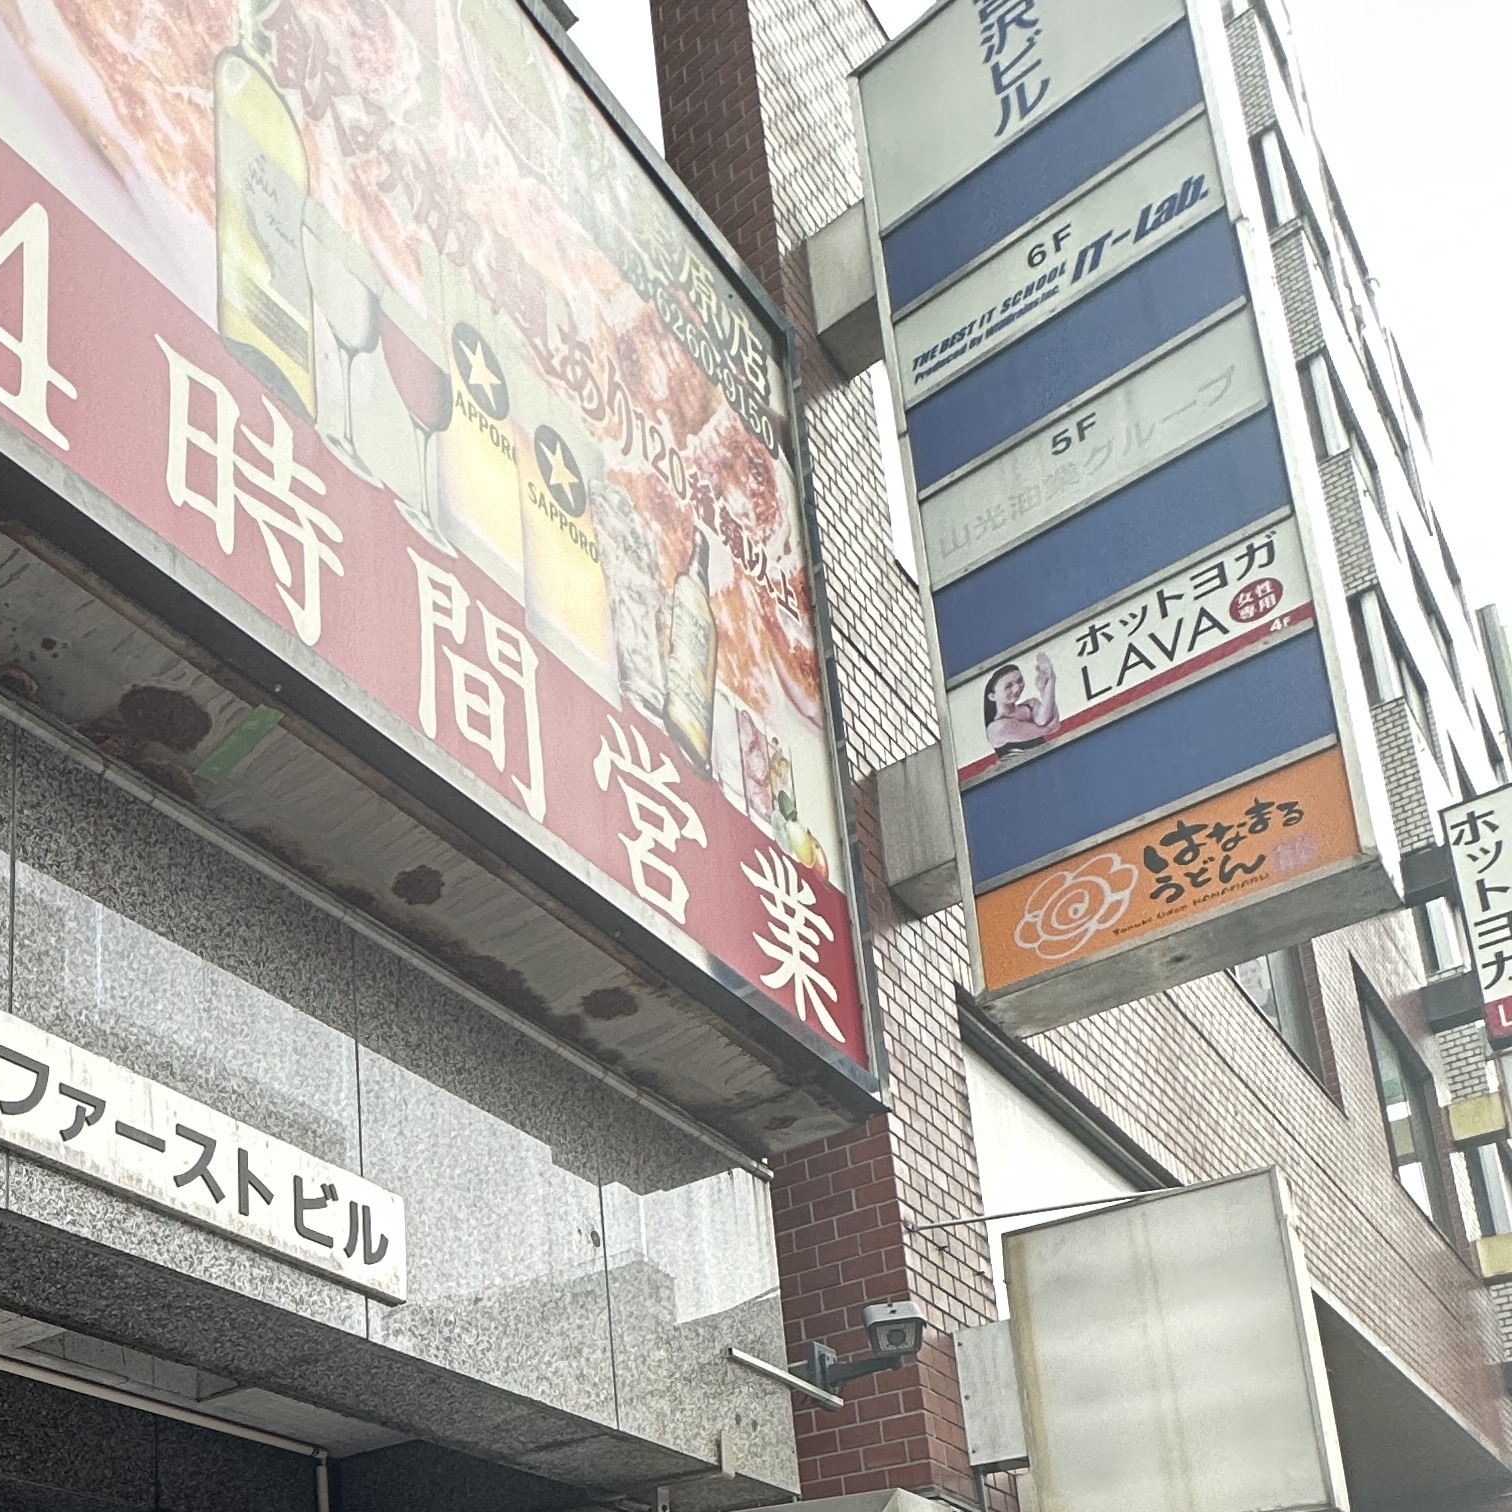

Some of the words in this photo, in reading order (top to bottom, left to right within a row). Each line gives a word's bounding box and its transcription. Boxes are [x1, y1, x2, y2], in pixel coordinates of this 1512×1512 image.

[976, 0, 1050, 137] 沢ビル
[1027, 222, 1072, 268] 6F
[1071, 174, 1209, 284] IT-Lab.
[940, 319, 977, 352] BEST
[1000, 261, 1068, 316] SCHOOL
[1050, 412, 1096, 456] 5F
[527, 481, 600, 564] SAPPORO
[1076, 532, 1277, 660] ホットヨガ
[1235, 579, 1276, 608] 女性
[1237, 595, 1277, 621] 専用
[1080, 608, 1230, 701] LAVA
[1143, 798, 1305, 874] はなまる
[1149, 851, 1267, 905] うどん
